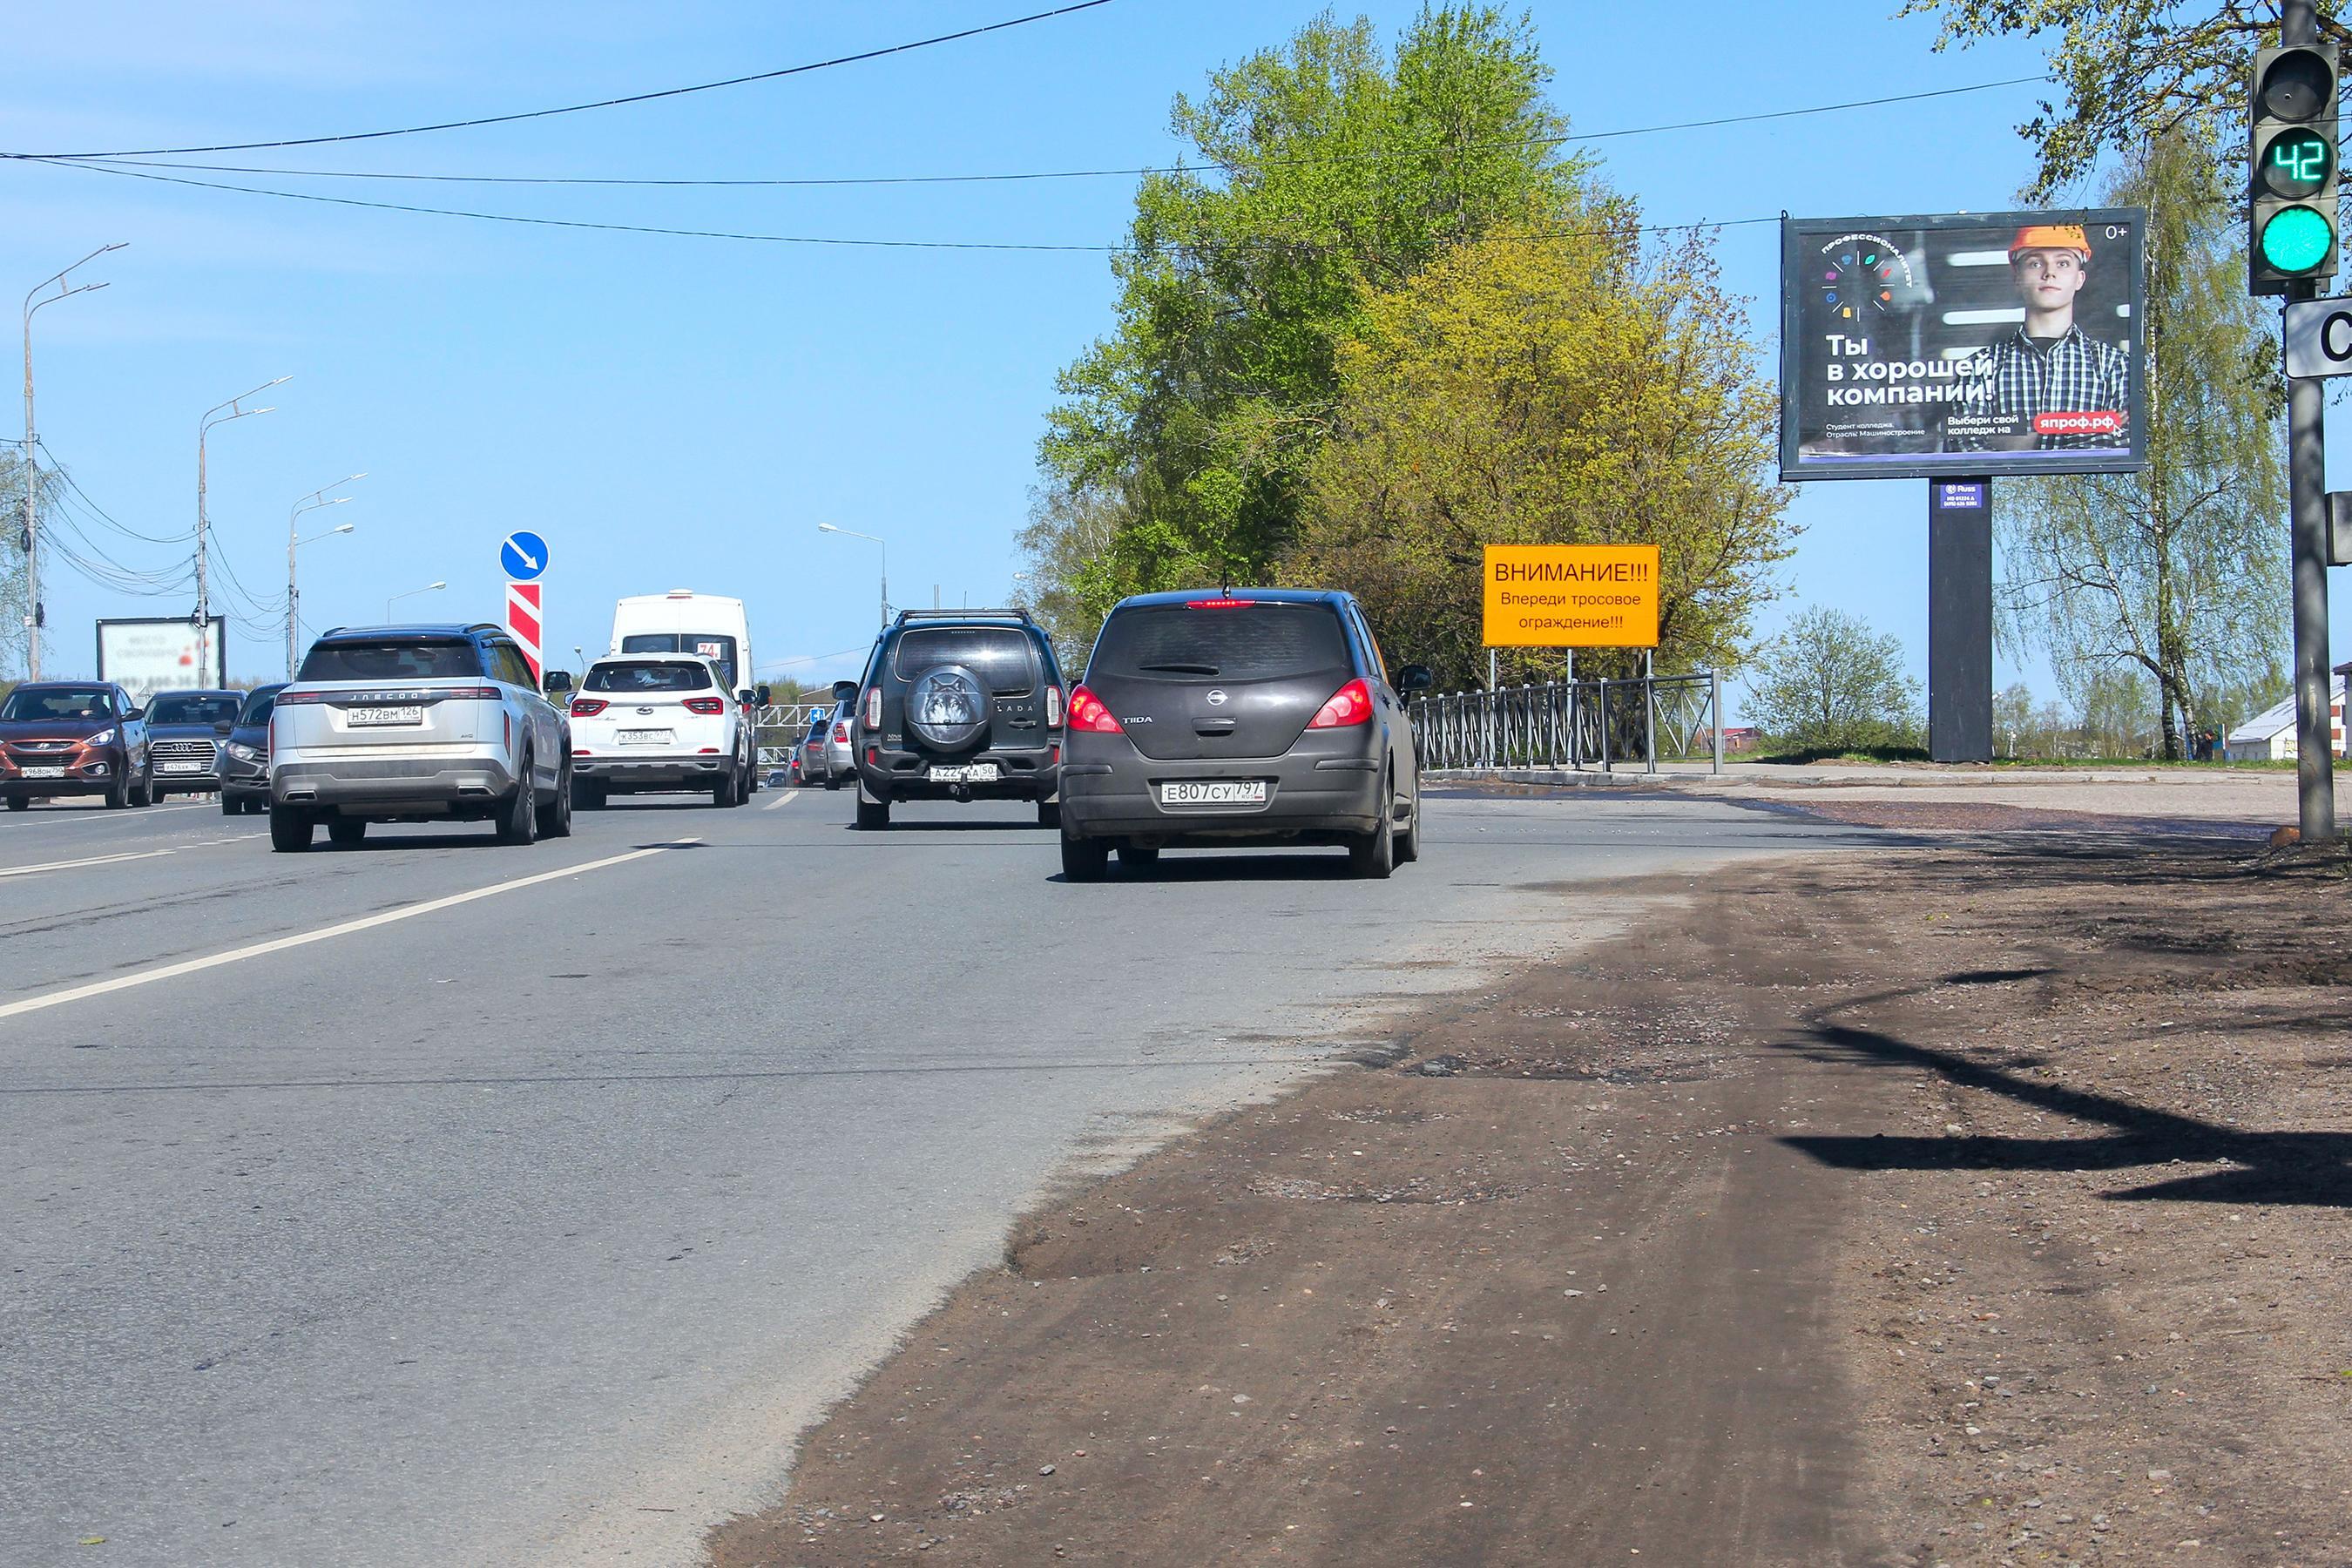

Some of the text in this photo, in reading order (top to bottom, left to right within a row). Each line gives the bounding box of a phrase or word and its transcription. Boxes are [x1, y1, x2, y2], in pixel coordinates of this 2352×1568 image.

[2274, 142, 2323, 180] 42
[1821, 233, 1913, 288] ПРОФЕССИОНАЛИТЕТ
[1826, 335, 1869, 356] Ты
[1827, 349, 1993, 385] в хорошей
[1827, 379, 1994, 406] компании!
[1947, 415, 2019, 425] Выбери свой
[2040, 415, 2114, 429] япроф.рф
[1947, 426, 1995, 436] колледж
[1495, 563, 1648, 582] ВНИМАНИЕ!!!
[1500, 591, 1641, 608] Впереди тросовое
[1518, 615, 1624, 631] ограждение!!!
[1167, 782, 1260, 800] Е807СУ 797
